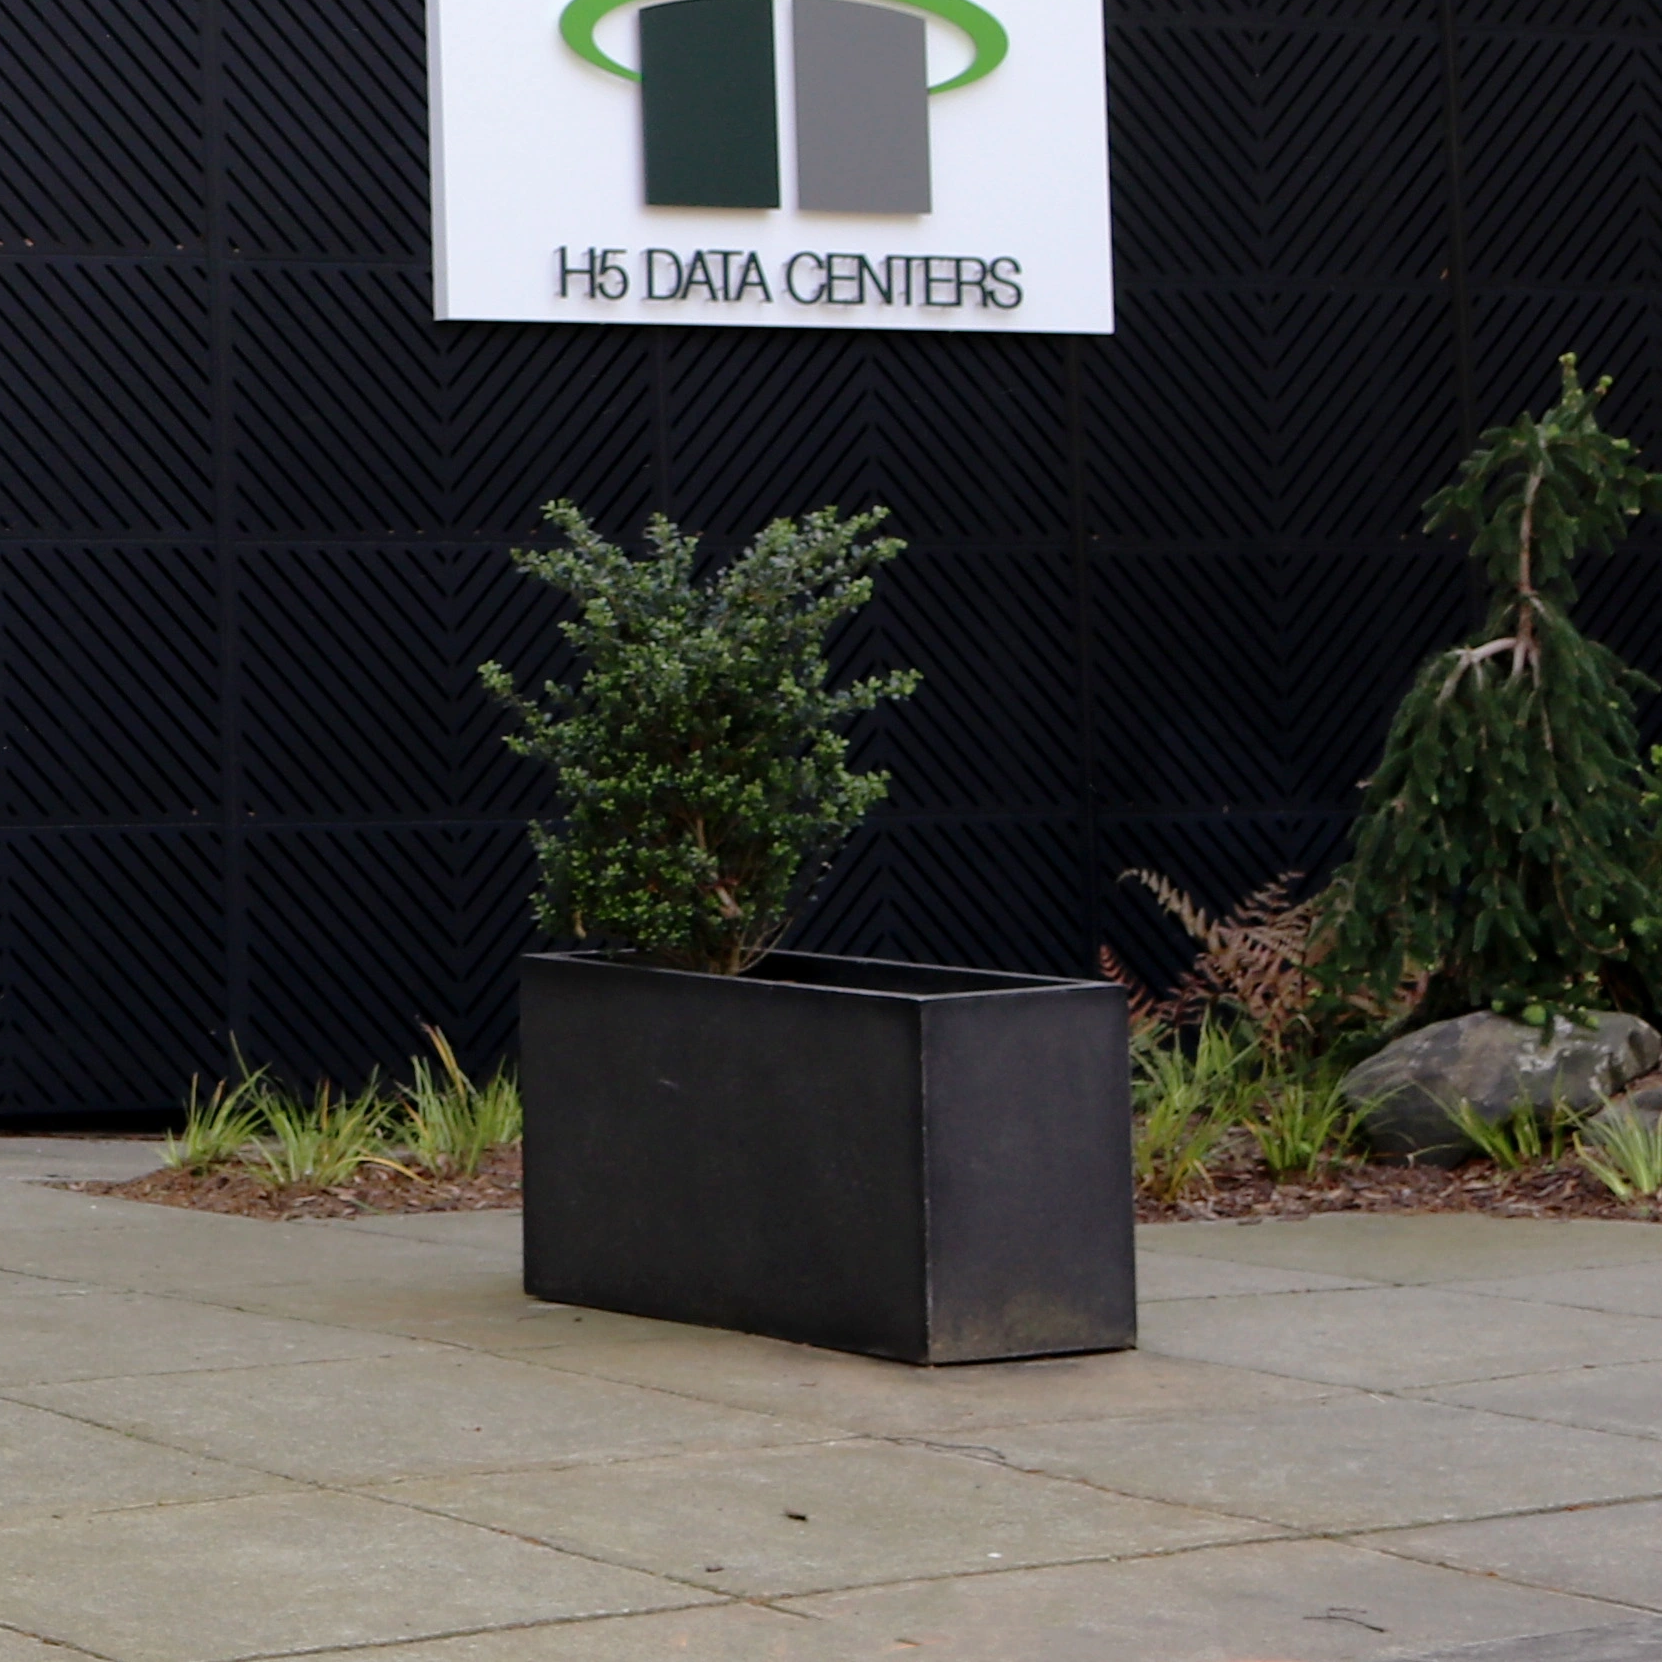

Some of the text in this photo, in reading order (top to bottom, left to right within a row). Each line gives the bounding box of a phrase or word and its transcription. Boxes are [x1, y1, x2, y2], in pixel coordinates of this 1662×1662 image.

[557, 246, 1024, 311] H5 DATA CENTERS
